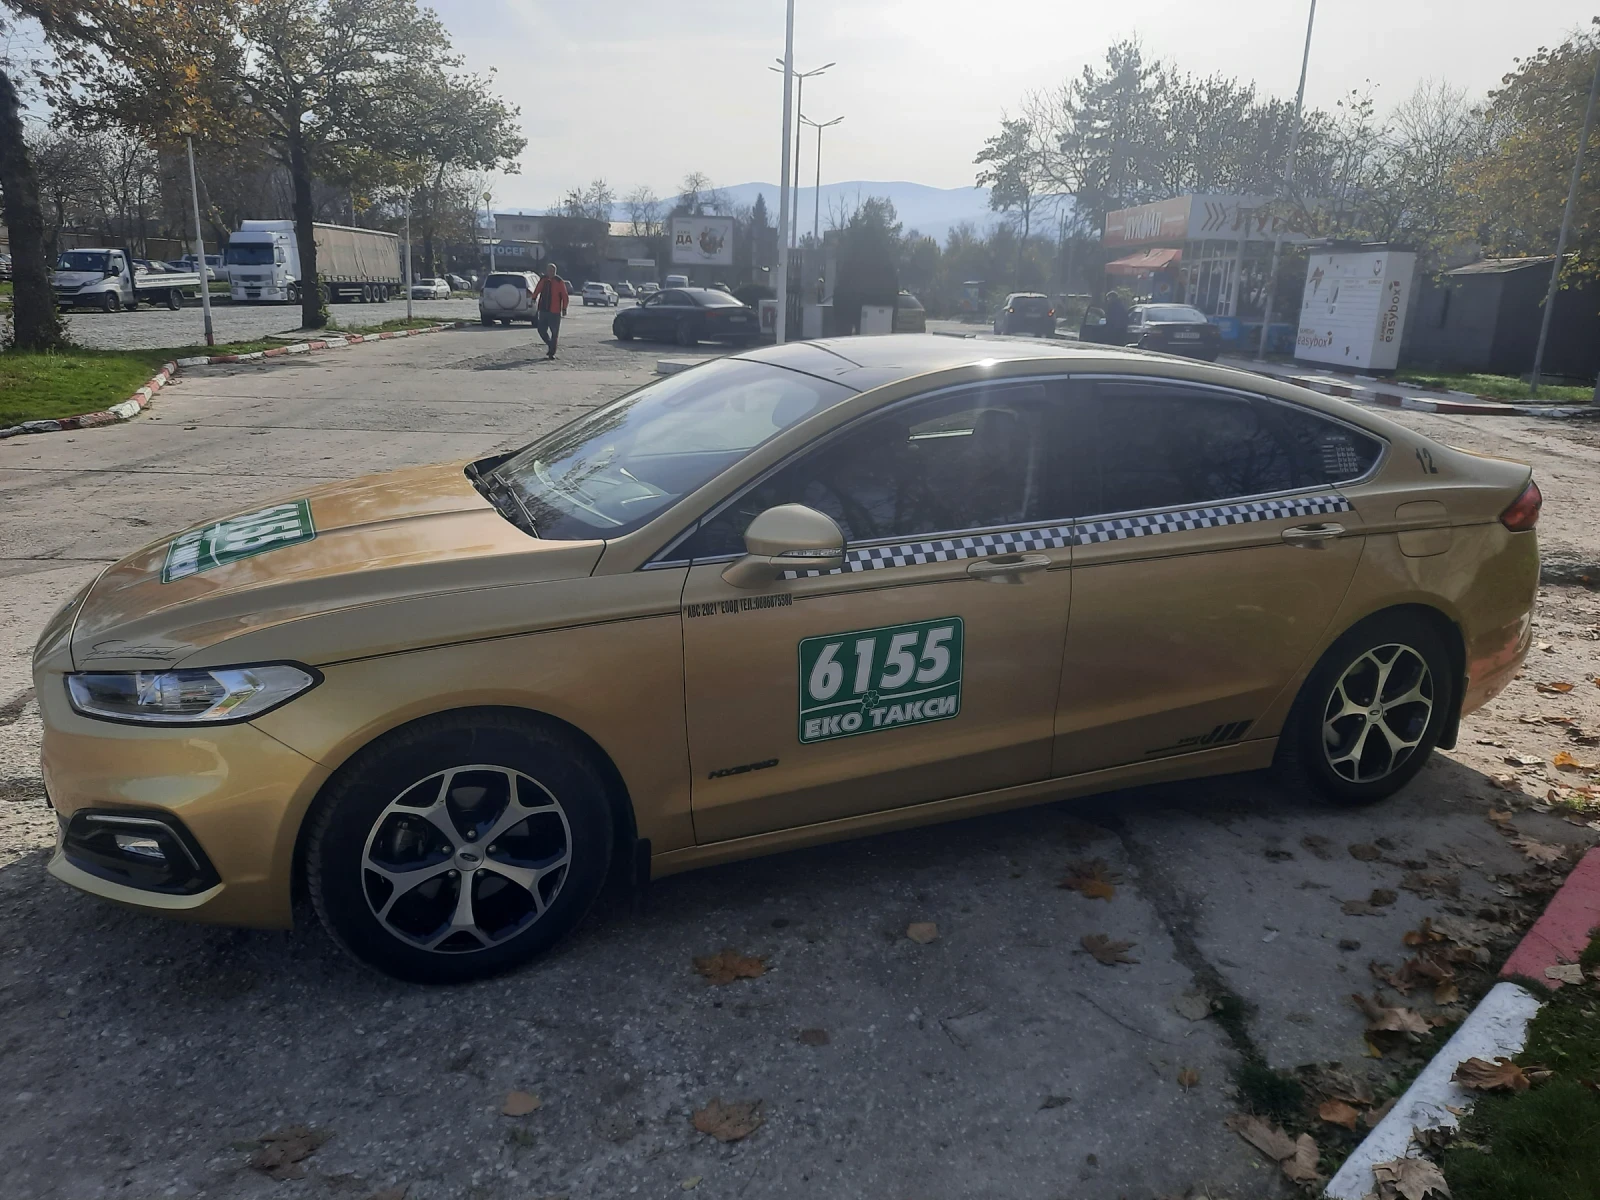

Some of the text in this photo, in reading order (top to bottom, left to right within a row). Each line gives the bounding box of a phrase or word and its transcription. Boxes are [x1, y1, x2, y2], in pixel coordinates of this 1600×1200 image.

[676, 235, 693, 245] ДА
[1385, 289, 1401, 343] easybox
[1298, 334, 1328, 349] easybox
[1415, 447, 1438, 474] 12
[809, 626, 954, 700] 6155
[804, 695, 957, 739] ЕКО ТАКСИ
